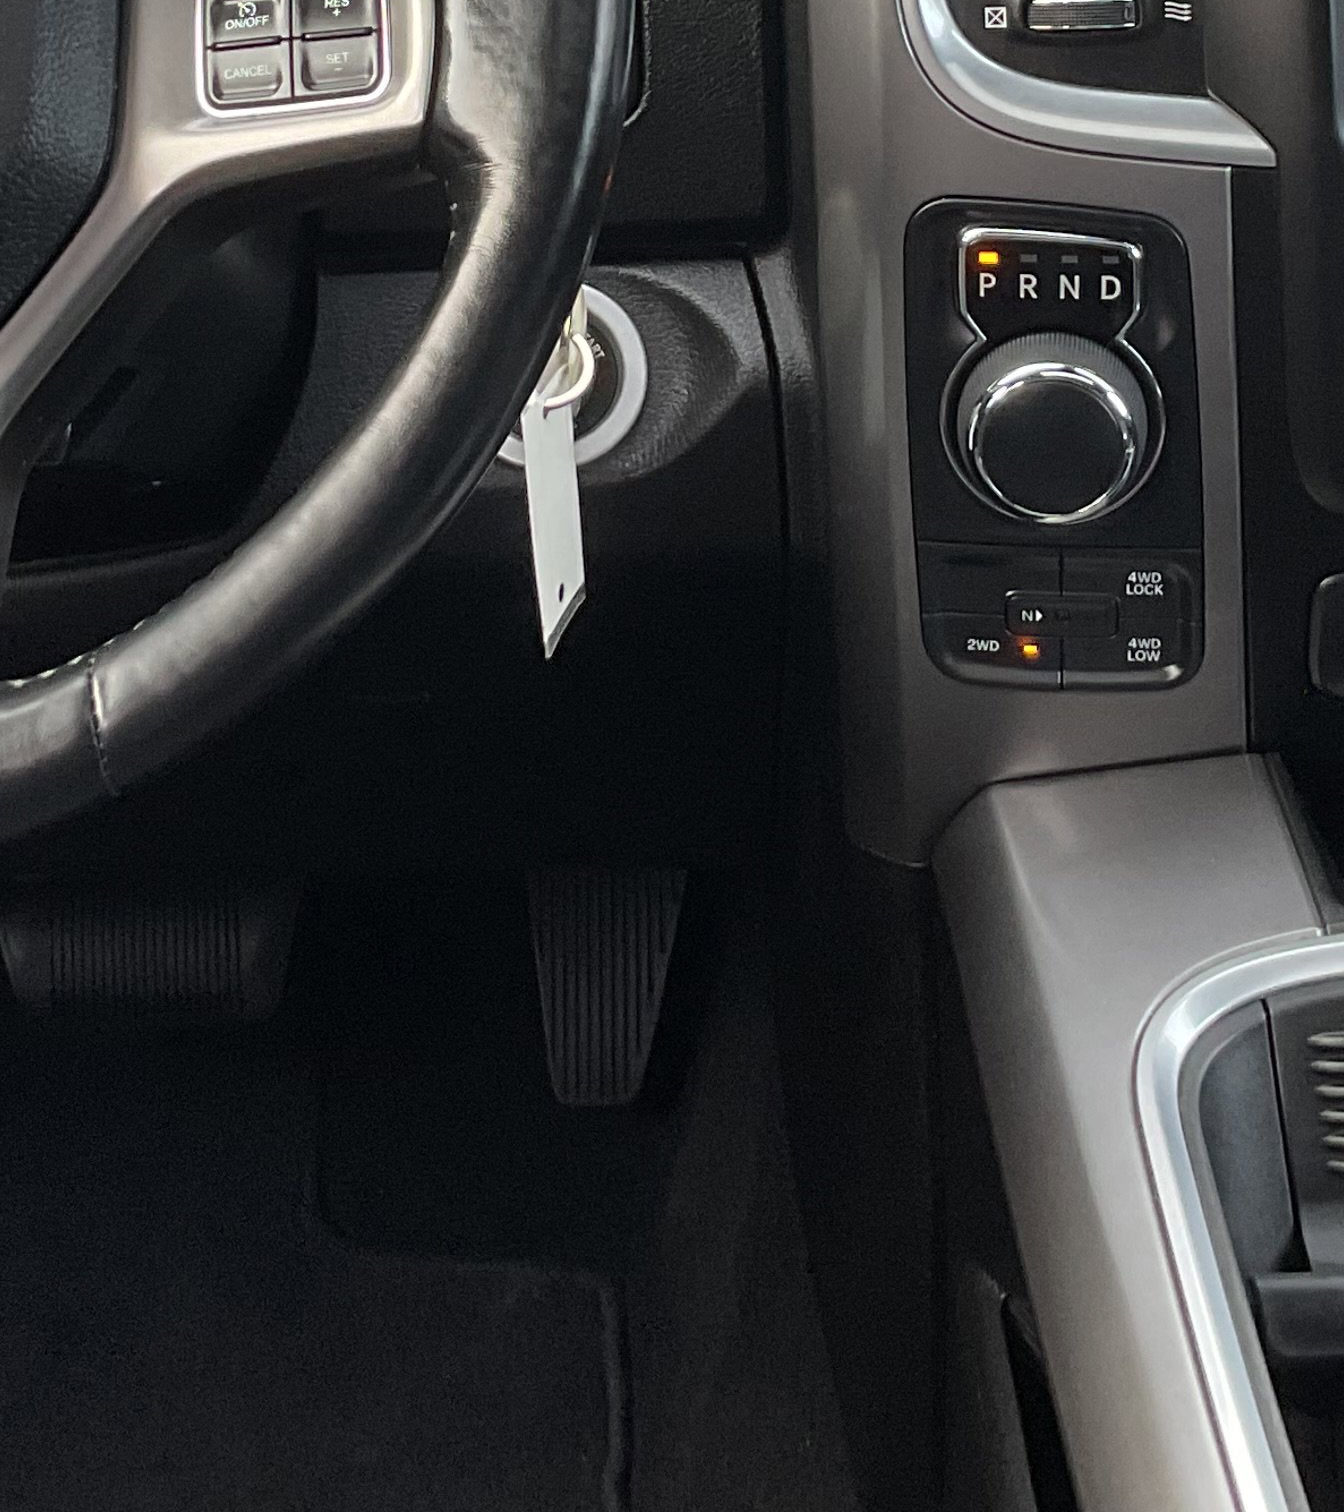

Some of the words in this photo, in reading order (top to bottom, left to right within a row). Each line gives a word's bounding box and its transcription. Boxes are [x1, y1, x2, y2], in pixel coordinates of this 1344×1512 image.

[224, 15, 270, 30] ON/OFF
[326, 52, 349, 64] SET
[224, 65, 272, 80] CANCEL
[978, 272, 997, 298] P
[1019, 273, 1038, 299] R
[1059, 274, 1080, 300] N
[1100, 275, 1122, 300] D
[1127, 571, 1162, 584] 4WD
[1125, 584, 1164, 595] LOCK
[1021, 610, 1033, 622] N
[967, 639, 1000, 652] 2WD
[1127, 638, 1161, 649] 4WD
[1126, 650, 1161, 662] LOW
